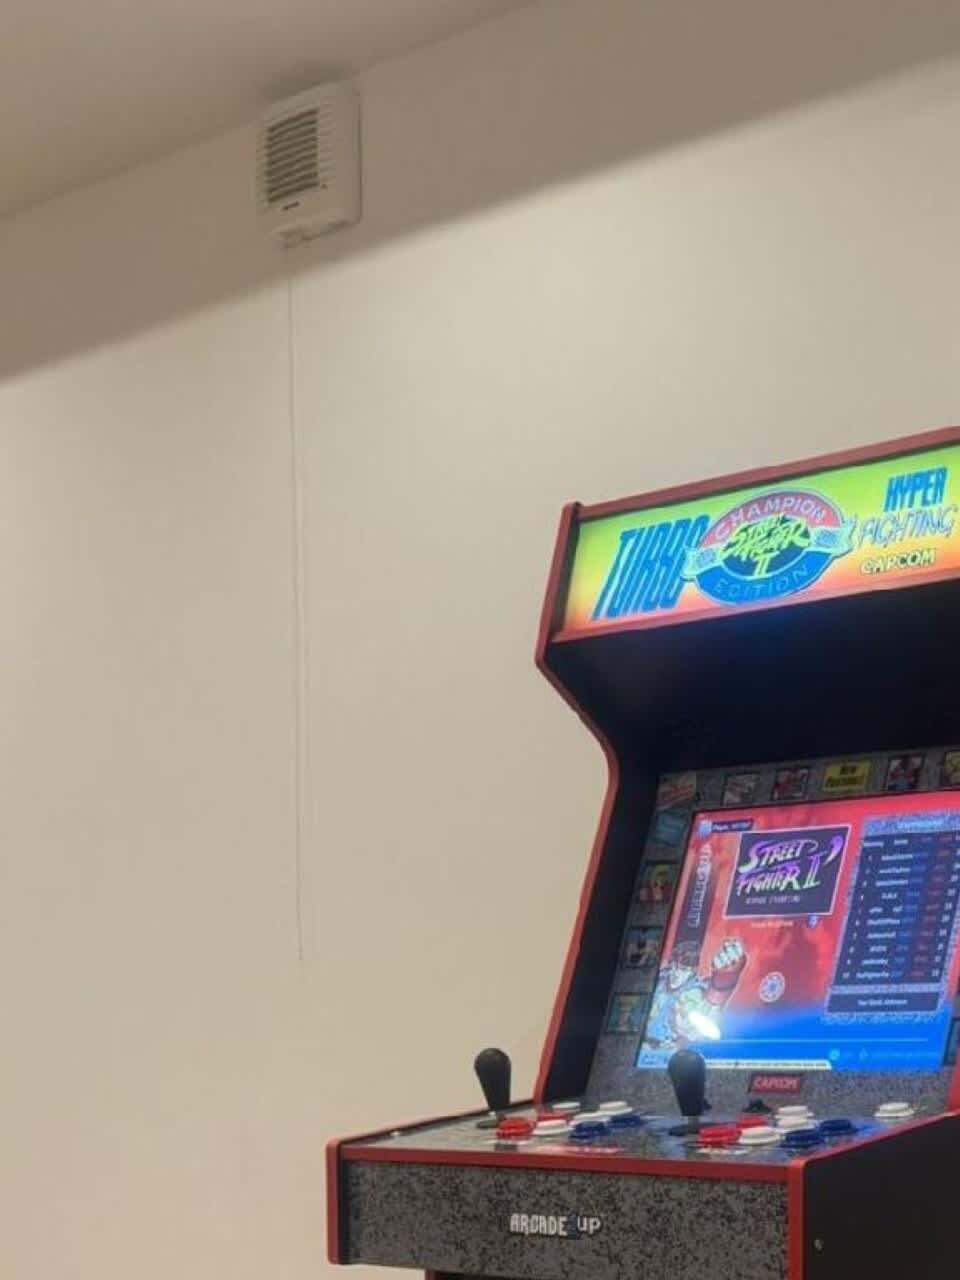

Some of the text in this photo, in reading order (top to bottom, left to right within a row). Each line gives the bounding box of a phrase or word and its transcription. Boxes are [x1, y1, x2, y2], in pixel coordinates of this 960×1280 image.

[883, 465, 948, 513] HYPER
[715, 496, 827, 540] CHAMPION
[859, 503, 958, 549] FIGHTING
[591, 514, 711, 621] TURBO
[860, 547, 937, 575] CAPCOM
[713, 563, 809, 597] EDITION
[738, 838, 819, 874] STREET
[737, 862, 801, 896] FIGHTER
[510, 1212, 568, 1237] ARCADE
